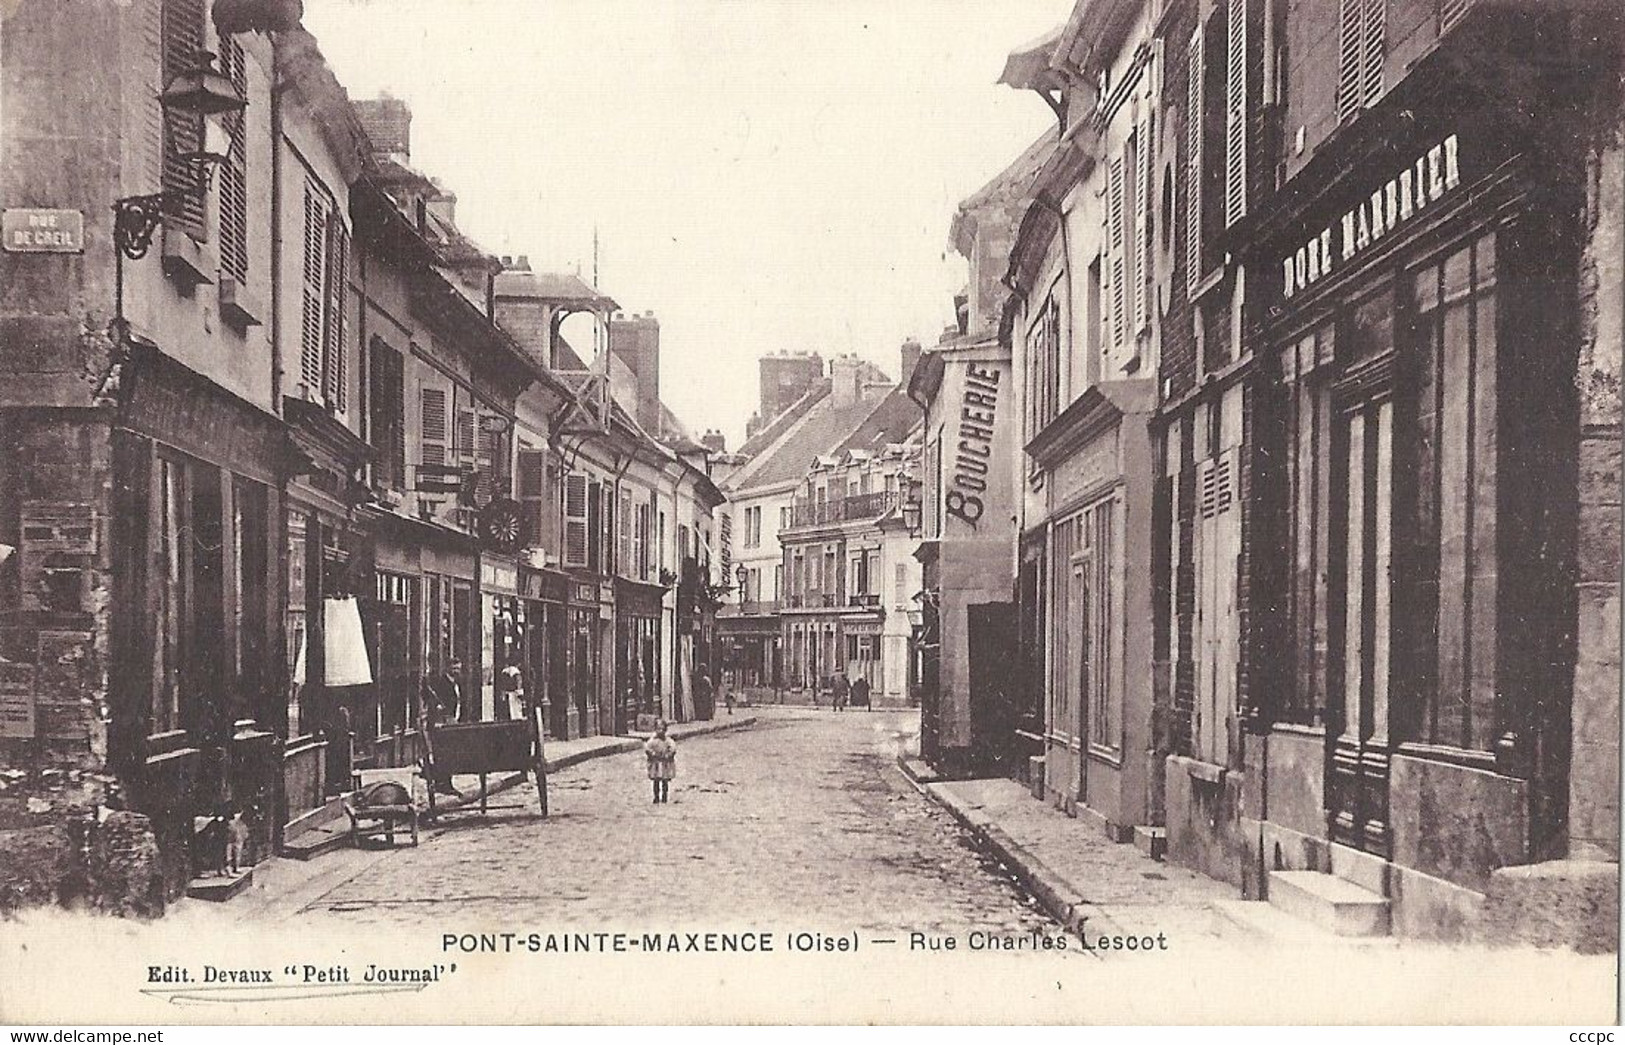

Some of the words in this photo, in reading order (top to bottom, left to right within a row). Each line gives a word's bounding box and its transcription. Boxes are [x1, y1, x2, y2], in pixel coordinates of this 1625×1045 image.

[14, 230, 34, 245] DE
[29, 214, 58, 228] RUE
[946, 362, 1001, 532] BOUCHERIE
[720, 511, 732, 598] CHARD-PATIN
